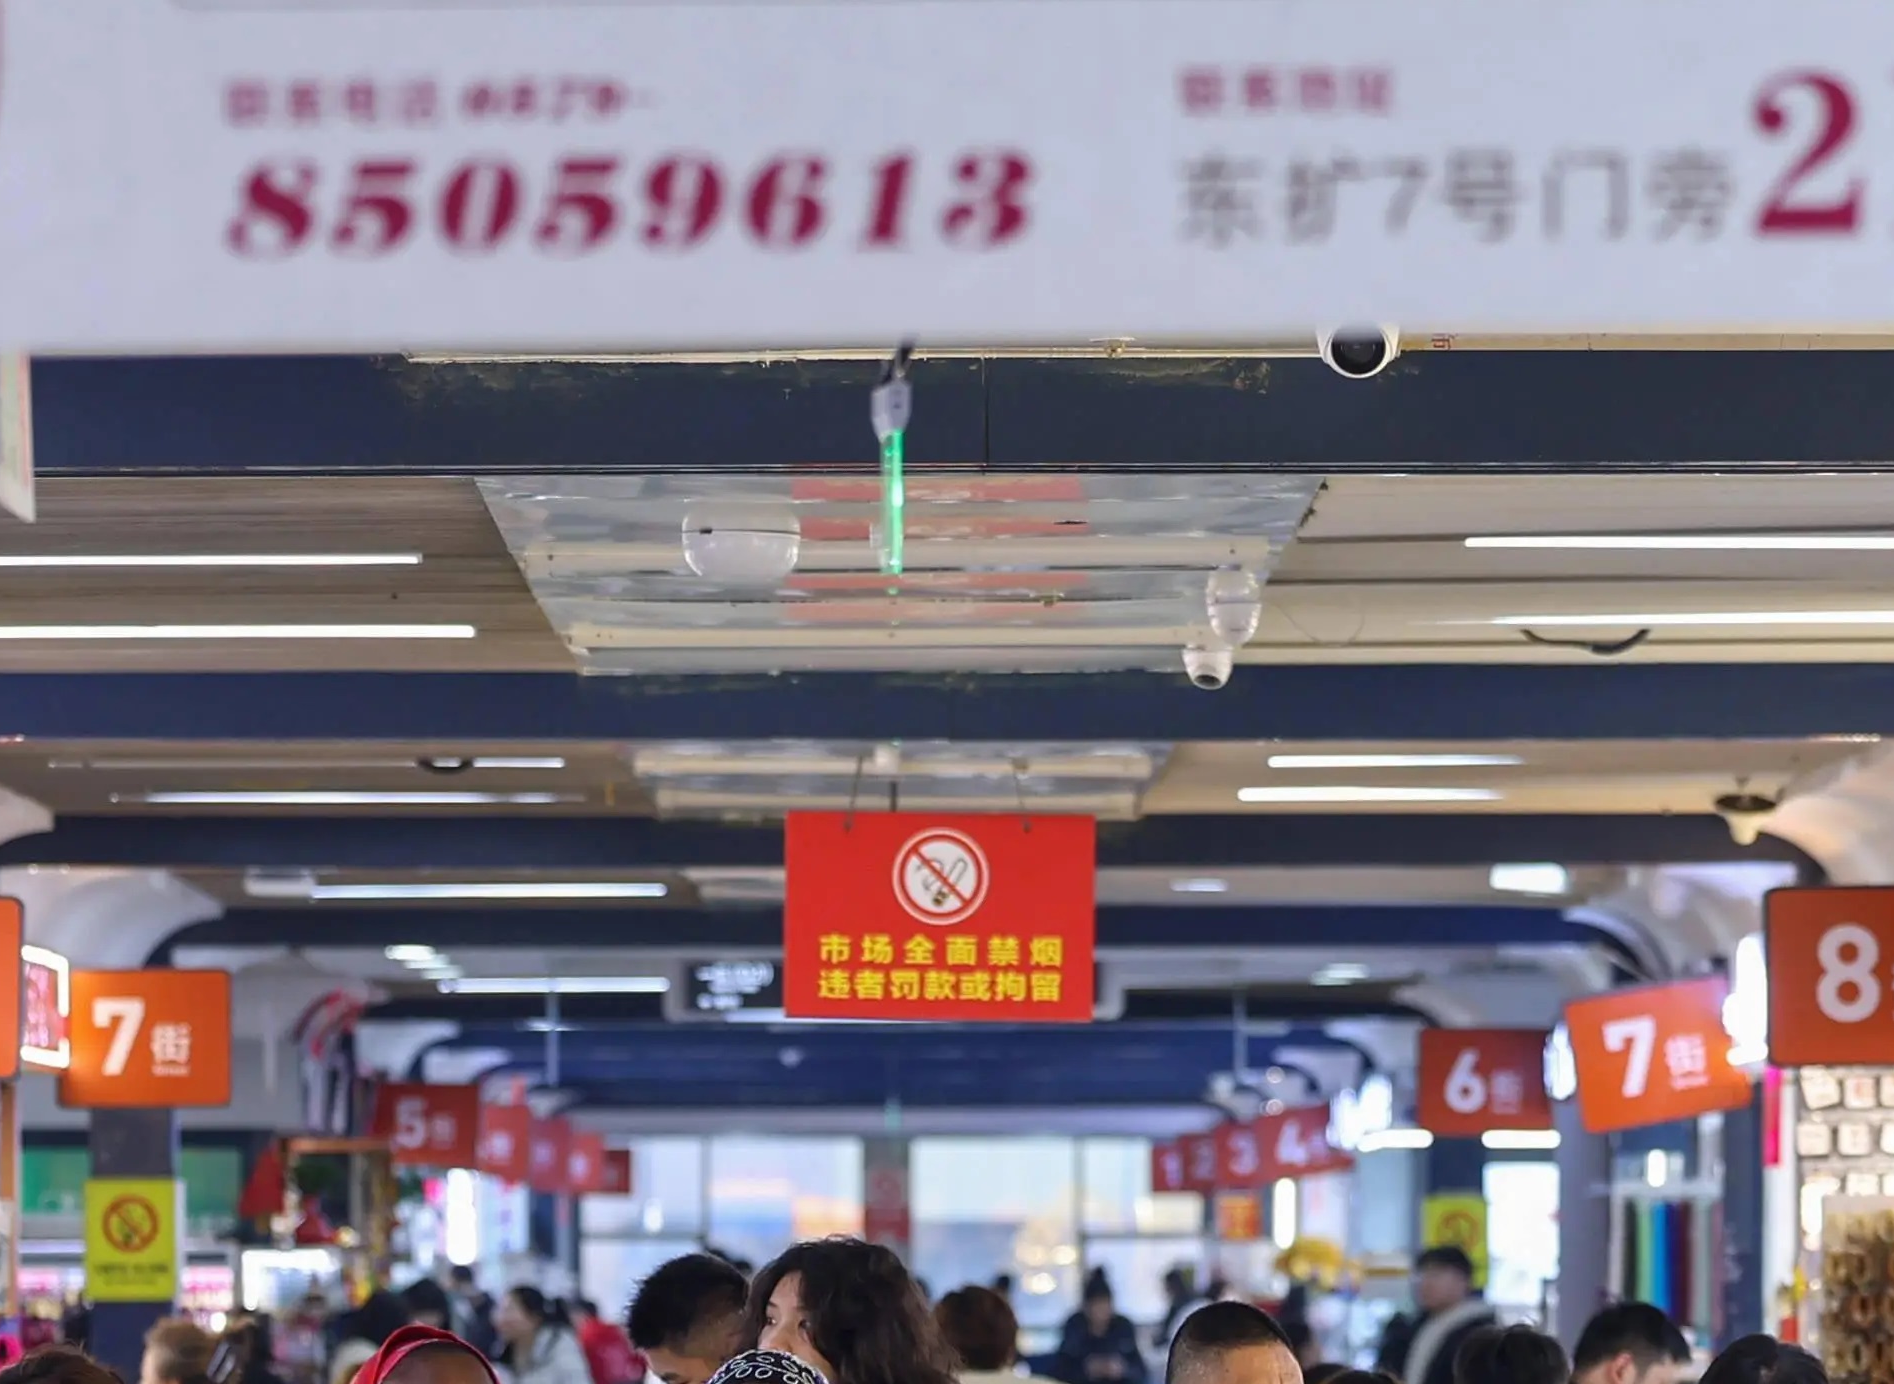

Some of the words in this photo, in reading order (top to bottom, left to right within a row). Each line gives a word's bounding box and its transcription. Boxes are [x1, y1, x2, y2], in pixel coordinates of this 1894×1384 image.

[225, 150, 1033, 253] 85059613
[818, 933, 1064, 968] 市场全面禁烟
[818, 969, 1062, 1003] 违者罚款或拘留
[1815, 924, 1881, 1024] 8
[92, 996, 146, 1077] 7
[1603, 1014, 1657, 1098] 7
[1443, 1048, 1487, 1114] 6
[394, 1096, 428, 1148] 5
